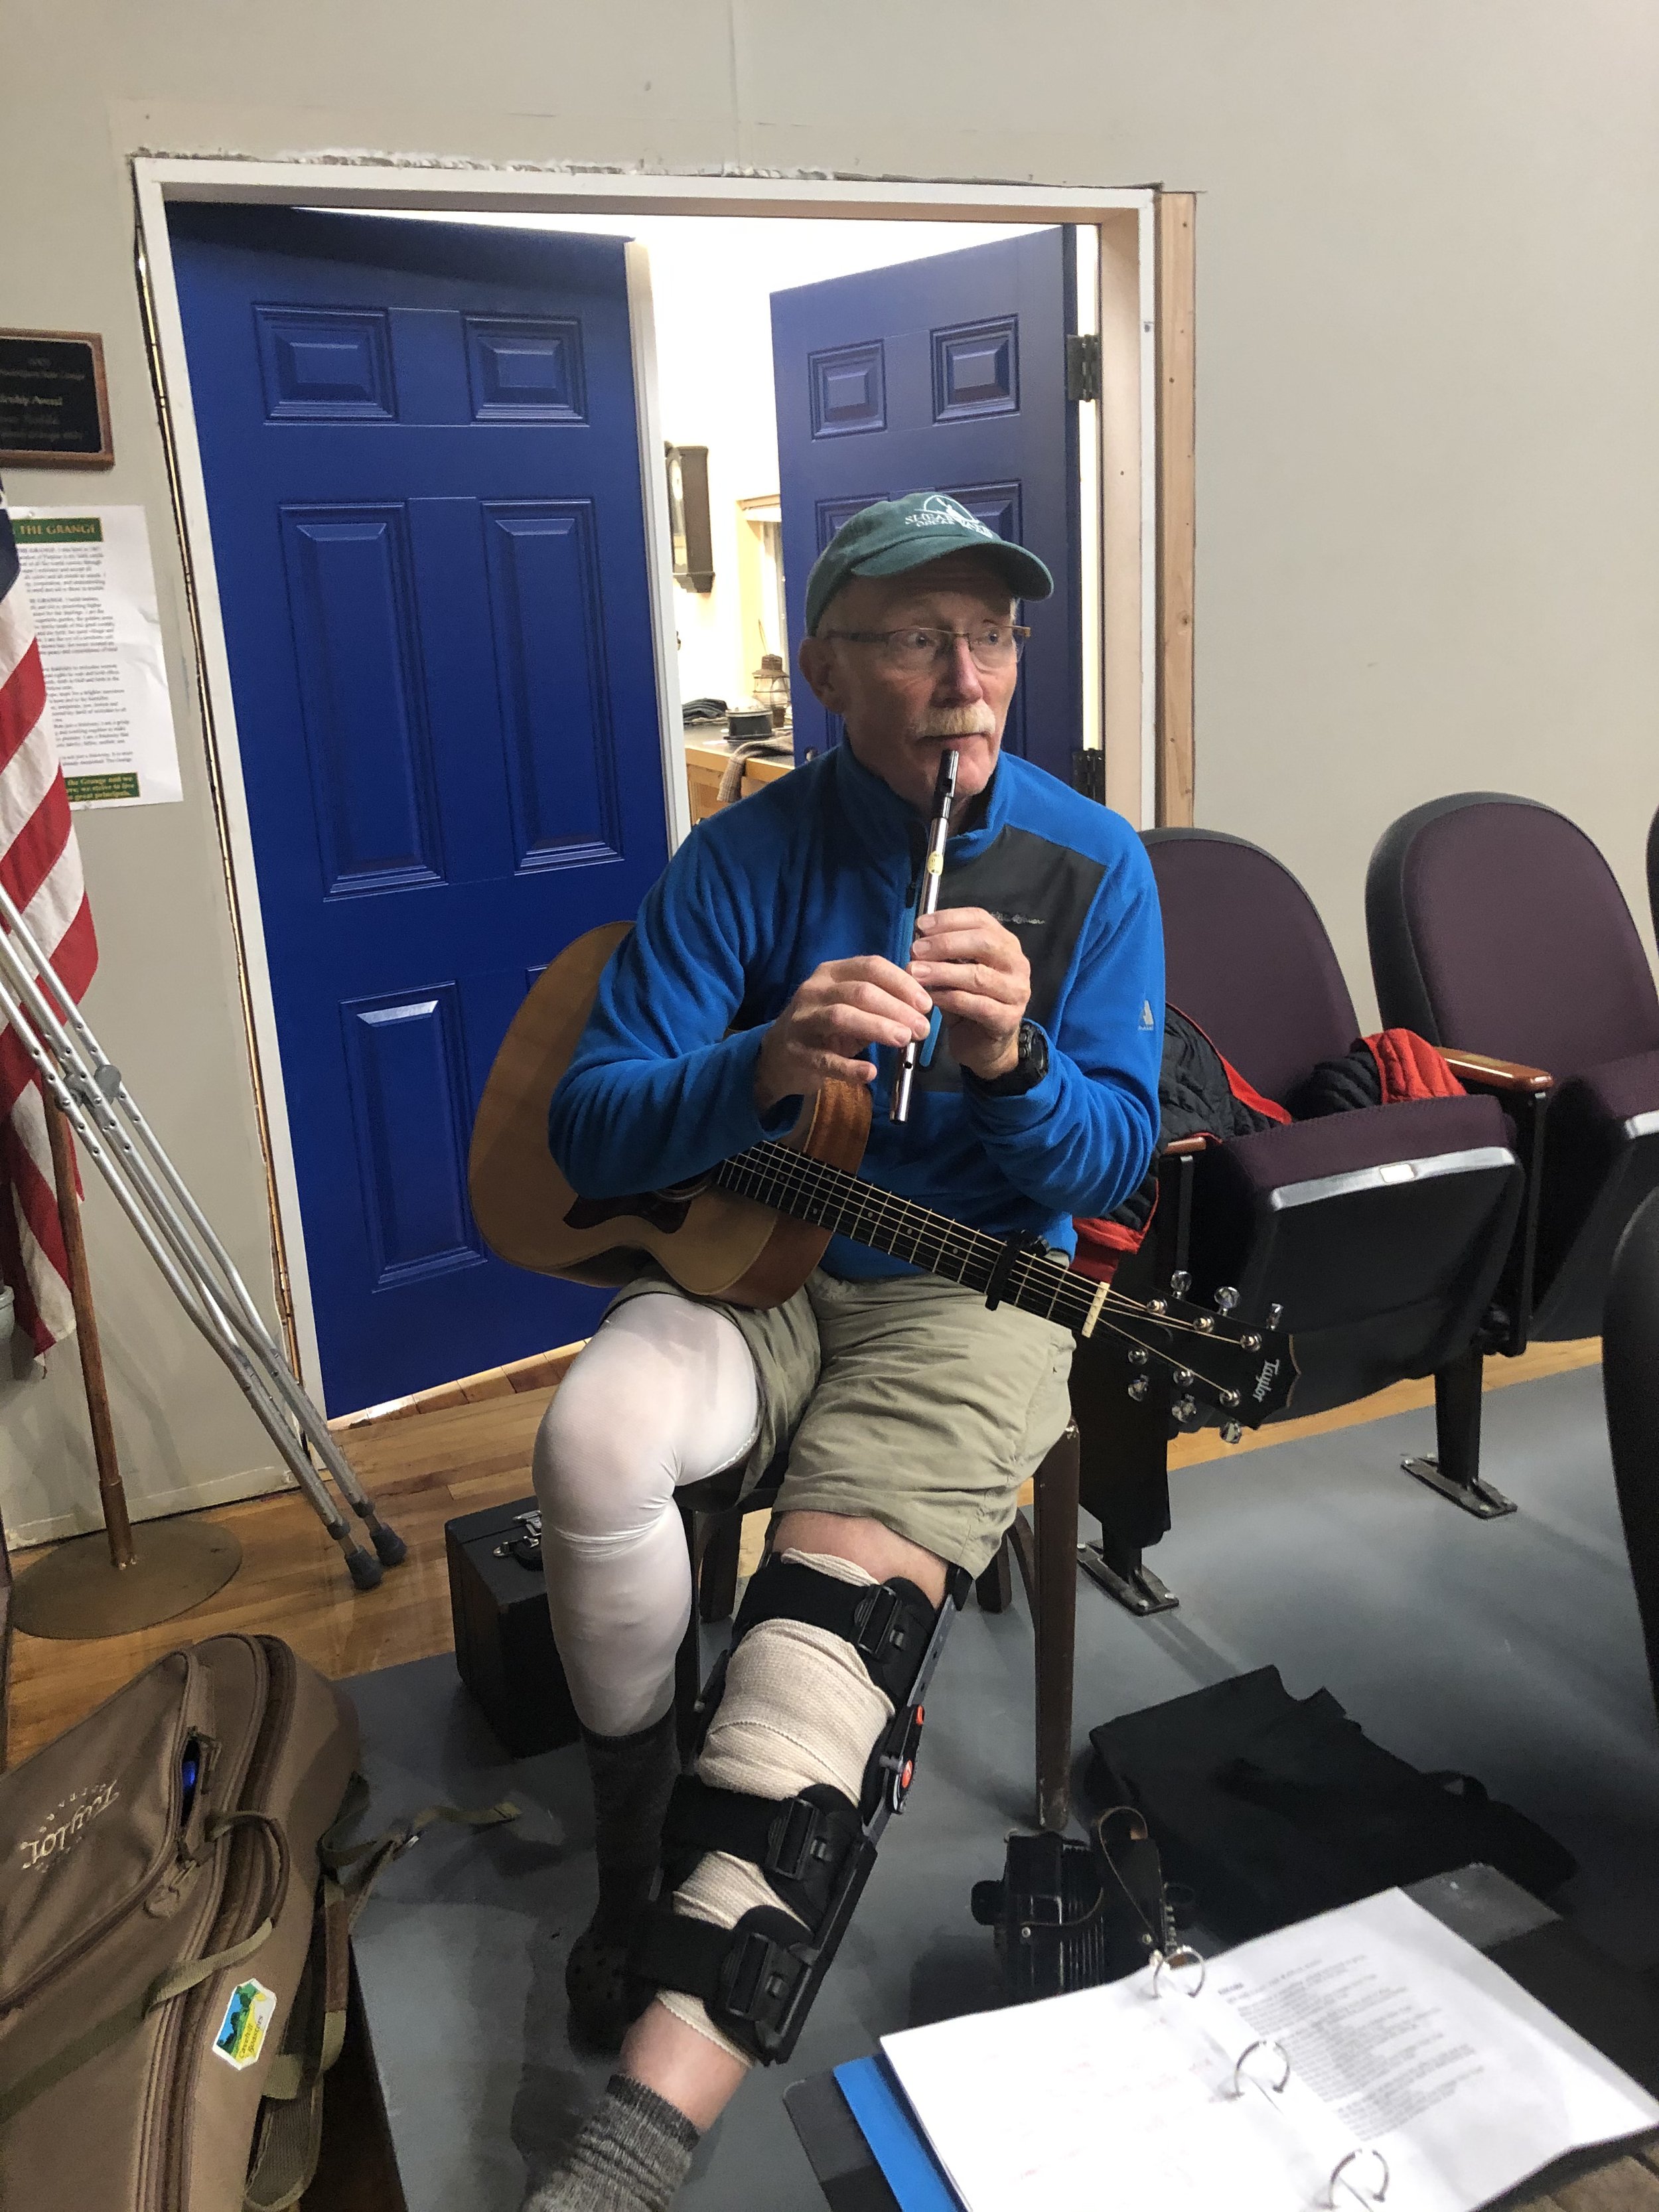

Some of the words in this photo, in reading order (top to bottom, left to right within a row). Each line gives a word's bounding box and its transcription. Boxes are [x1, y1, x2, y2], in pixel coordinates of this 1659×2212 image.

[1252, 1359, 1280, 1402] Taylor
[20, 1779, 120, 1870] Taylor
[238, 2024, 253, 2059] Cavehill
[248, 2015, 263, 2053] Roasters
